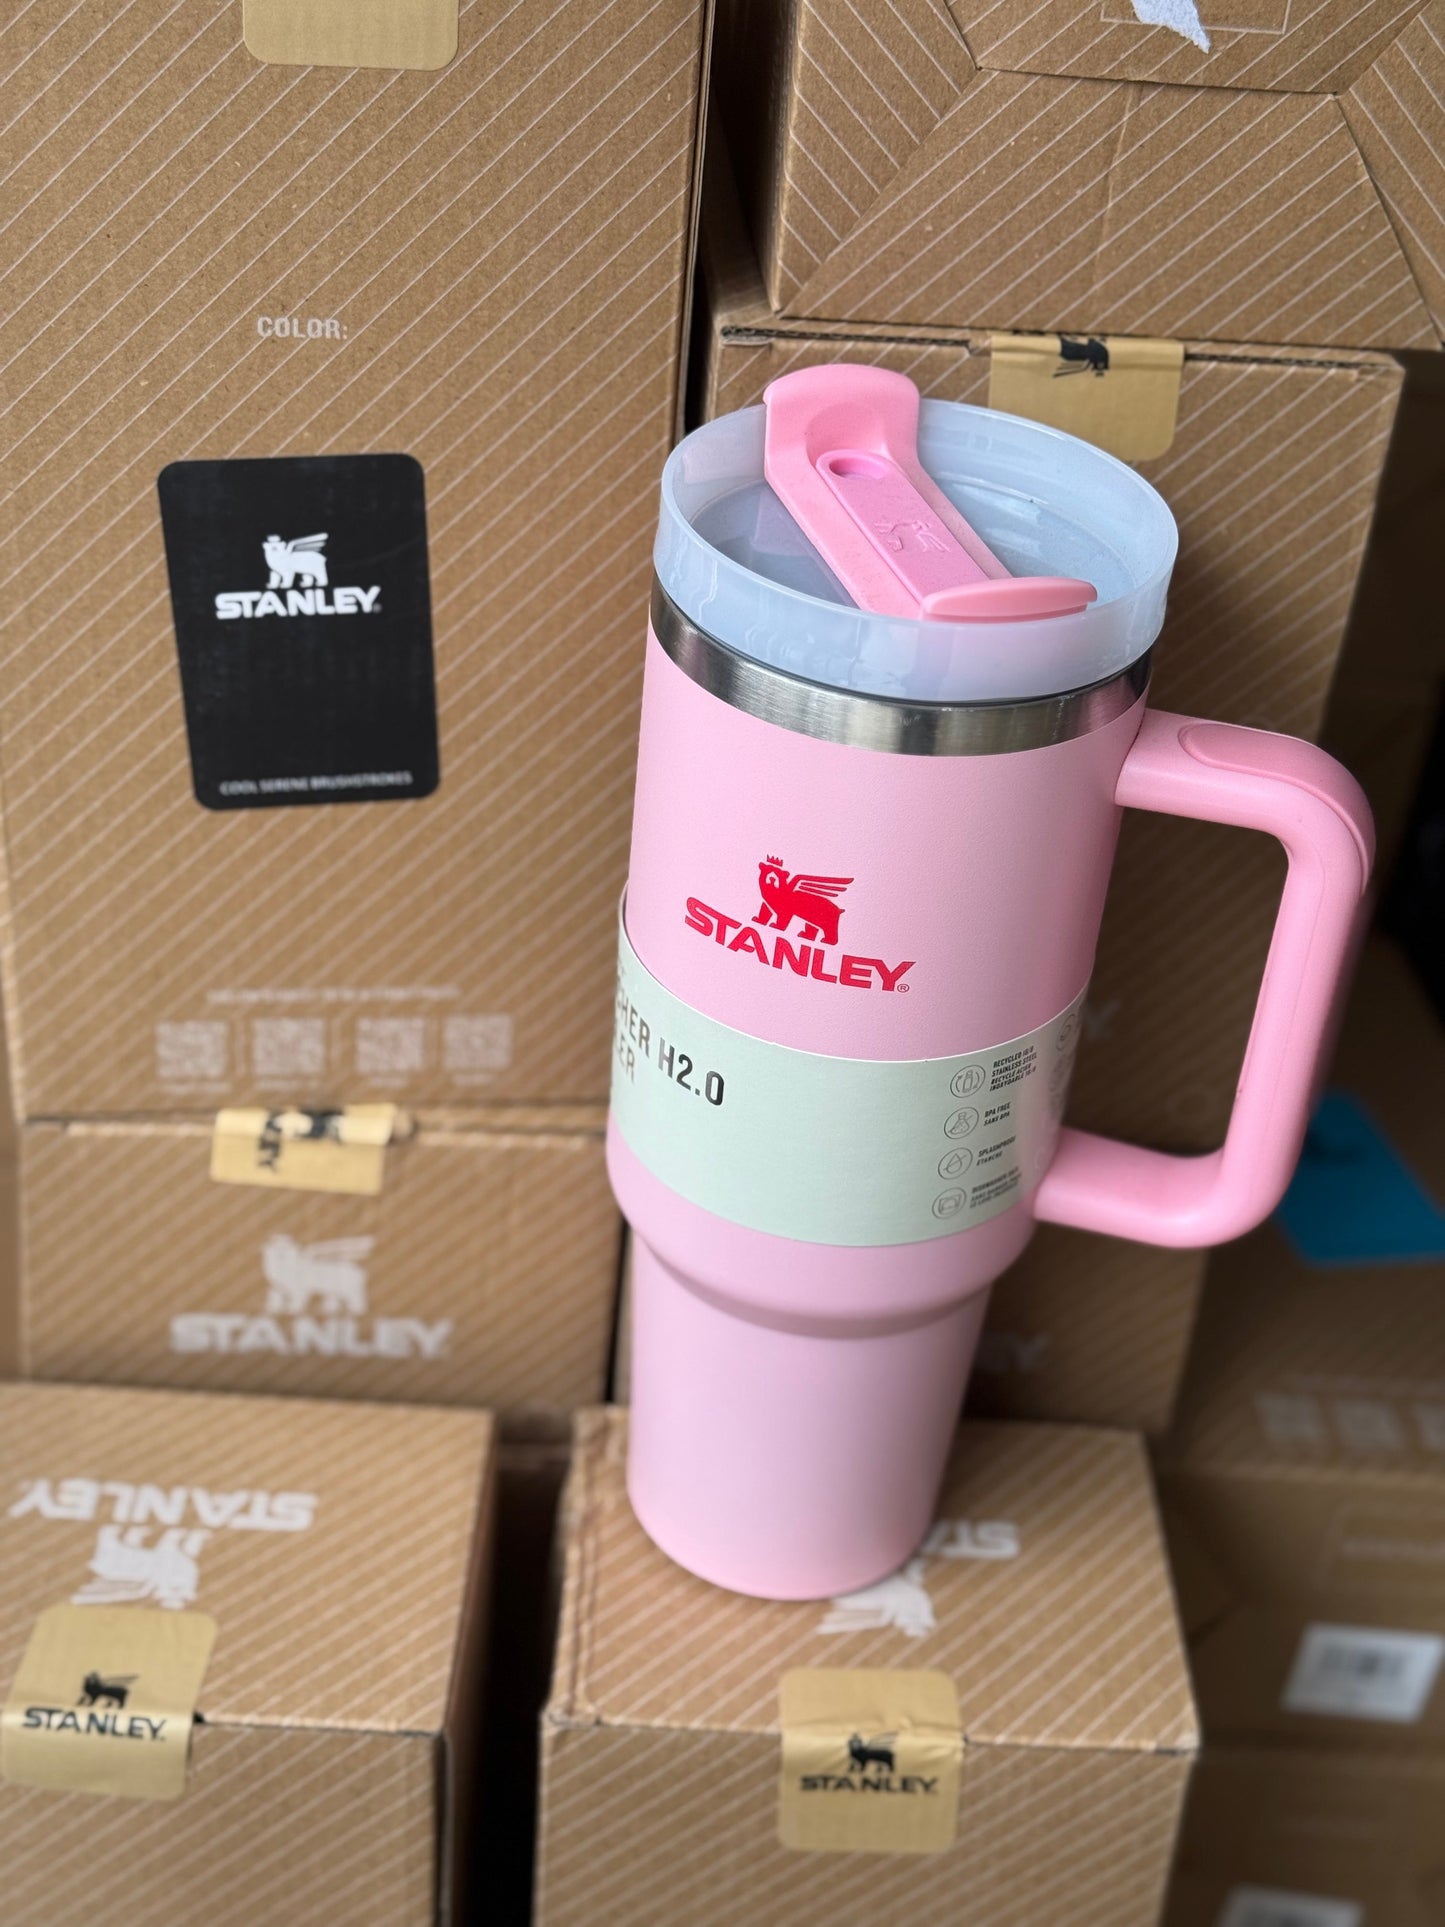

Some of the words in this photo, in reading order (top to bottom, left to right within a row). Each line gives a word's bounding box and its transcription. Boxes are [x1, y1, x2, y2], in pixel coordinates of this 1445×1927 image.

[257, 316, 348, 340] COLOR:
[215, 586, 383, 620] STANLEY
[658, 1037, 725, 1106] H2.0
[991, 1059, 1023, 1078] STAINLESS
[169, 1312, 454, 1359] STANLEY
[7, 1477, 318, 1533] STANLEY
[23, 1706, 167, 1742] STANLEY
[799, 1774, 939, 1796] STANLEY
